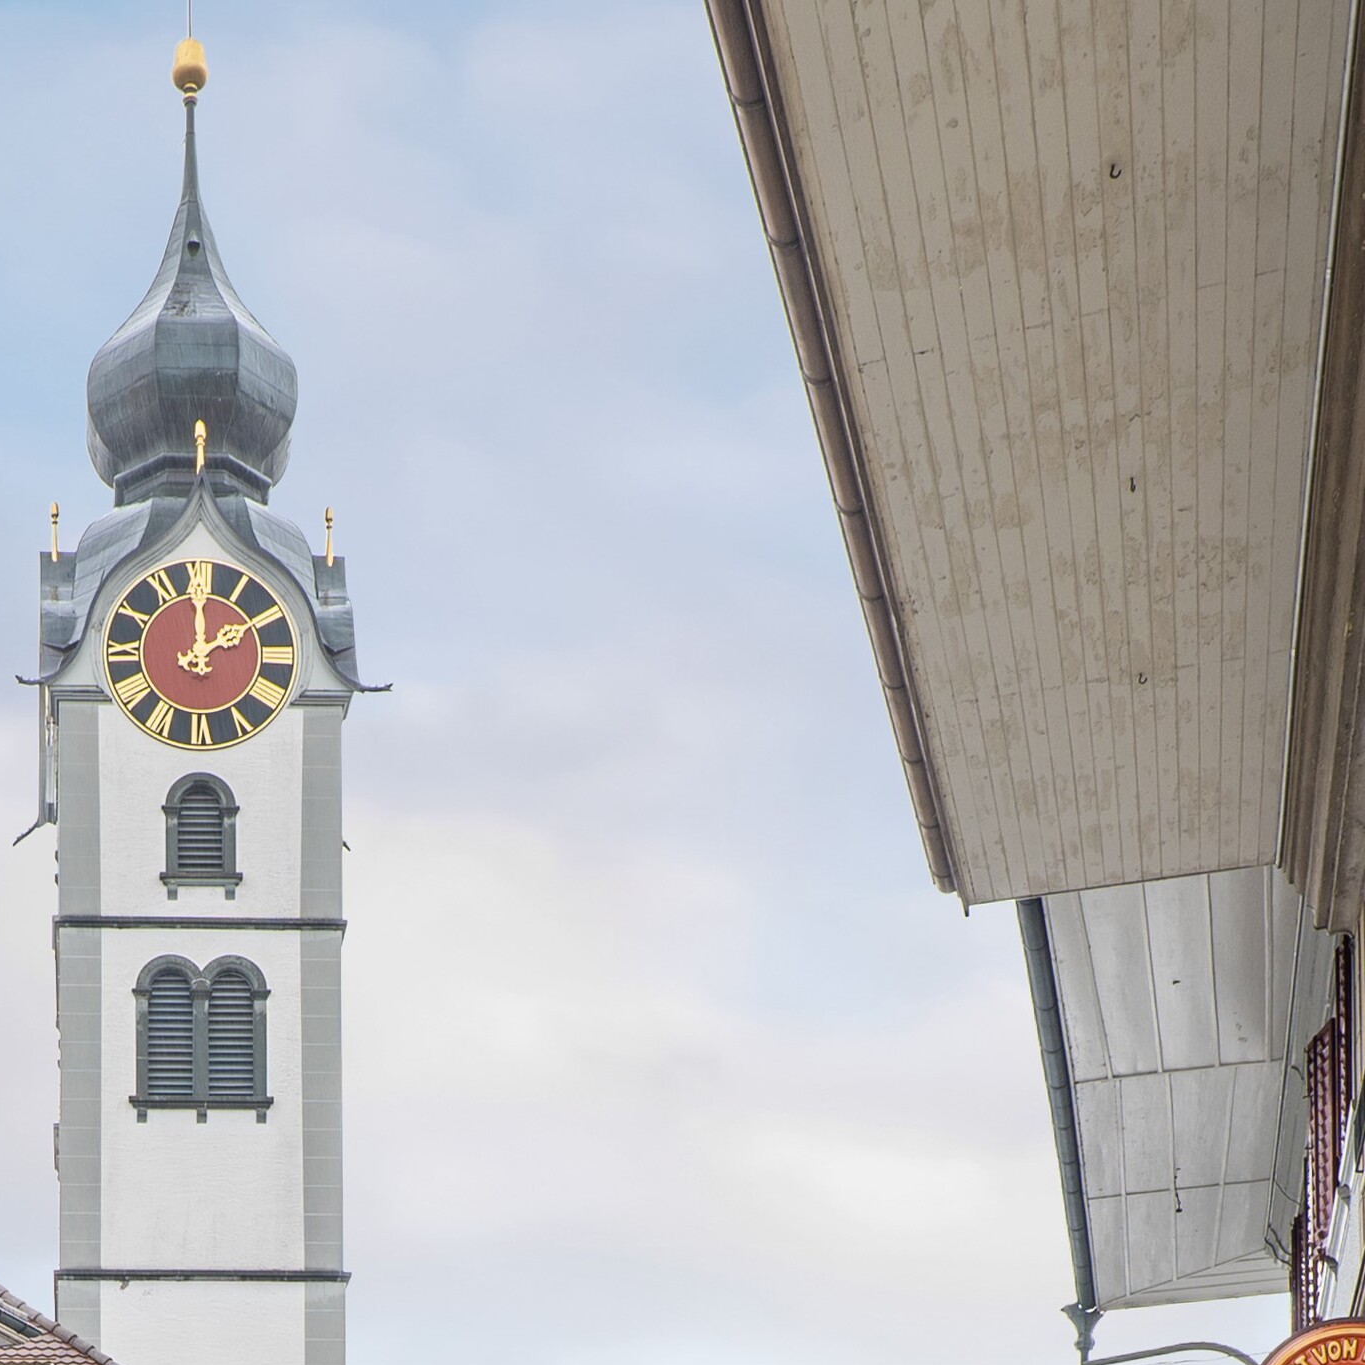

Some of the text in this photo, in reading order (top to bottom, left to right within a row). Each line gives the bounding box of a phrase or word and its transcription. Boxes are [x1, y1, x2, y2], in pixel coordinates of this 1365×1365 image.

[118, 600, 150, 629] X
[262, 646, 293, 665] III
[1311, 1338, 1358, 1365] VON
